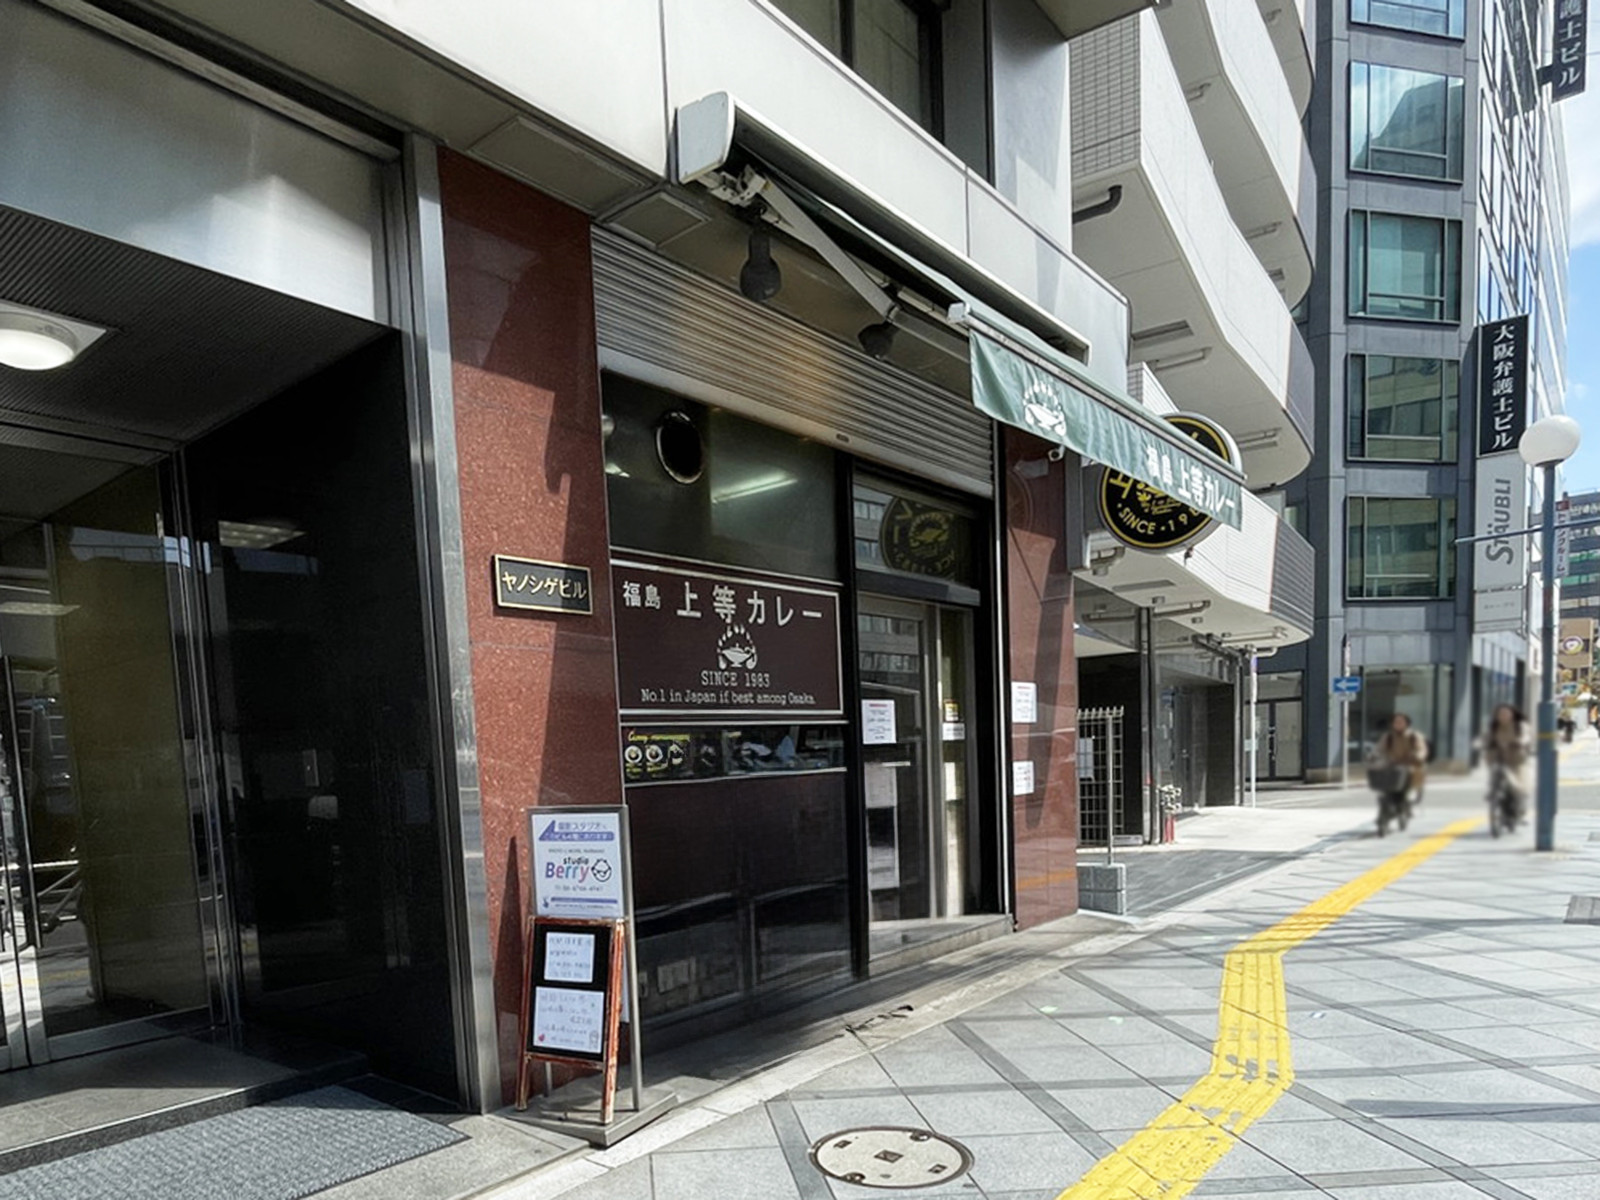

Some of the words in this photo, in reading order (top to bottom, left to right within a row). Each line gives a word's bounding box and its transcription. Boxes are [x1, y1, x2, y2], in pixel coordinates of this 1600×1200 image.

[1492, 324, 1515, 449] 大阪弁護士ビル
[1178, 458, 1236, 513] 上等カレー
[1118, 508, 1157, 535] SINCE
[502, 571, 587, 600] ヤノシゲビル
[622, 580, 661, 610] 福島
[677, 581, 822, 627] 上等カレー
[701, 670, 738, 687] SINCE
[745, 672, 770, 689] 1983
[670, 689, 683, 702] in
[685, 690, 717, 705] Japan
[719, 691, 730, 704] if
[731, 691, 755, 704] best
[756, 694, 787, 707] among
[545, 862, 590, 883] Berry
[563, 857, 590, 865] studio
